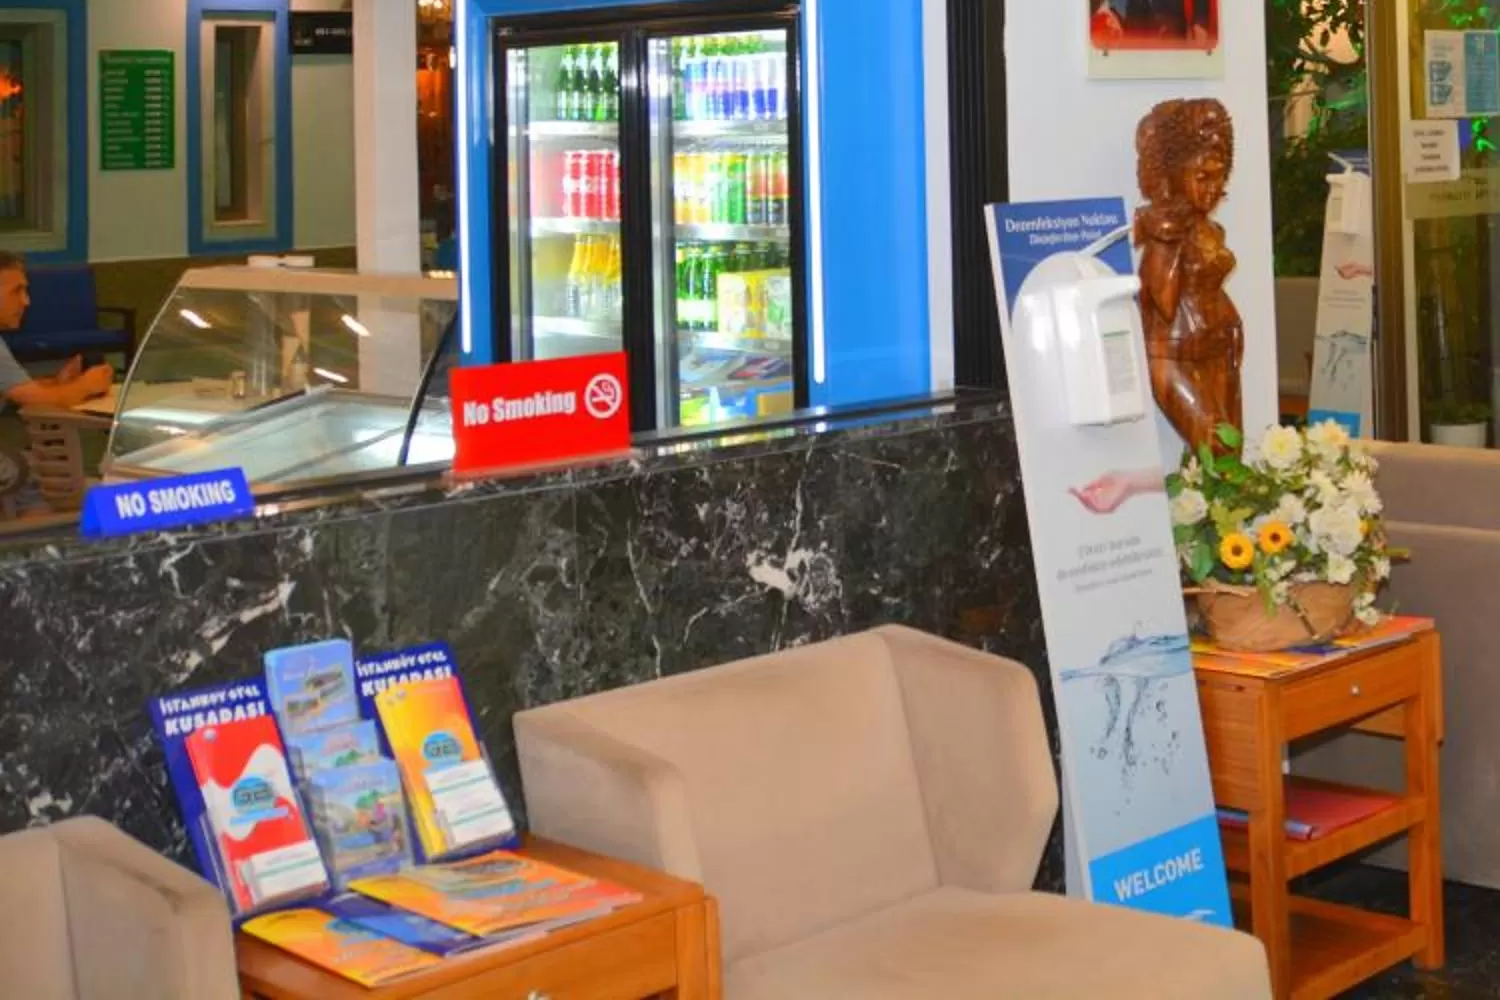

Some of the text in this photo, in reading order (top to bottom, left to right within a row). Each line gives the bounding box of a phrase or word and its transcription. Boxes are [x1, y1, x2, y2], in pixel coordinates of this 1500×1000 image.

[463, 389, 577, 428] No Smoking
[114, 479, 236, 519] NO SMOKING
[1113, 846, 1205, 903] WELCOME
